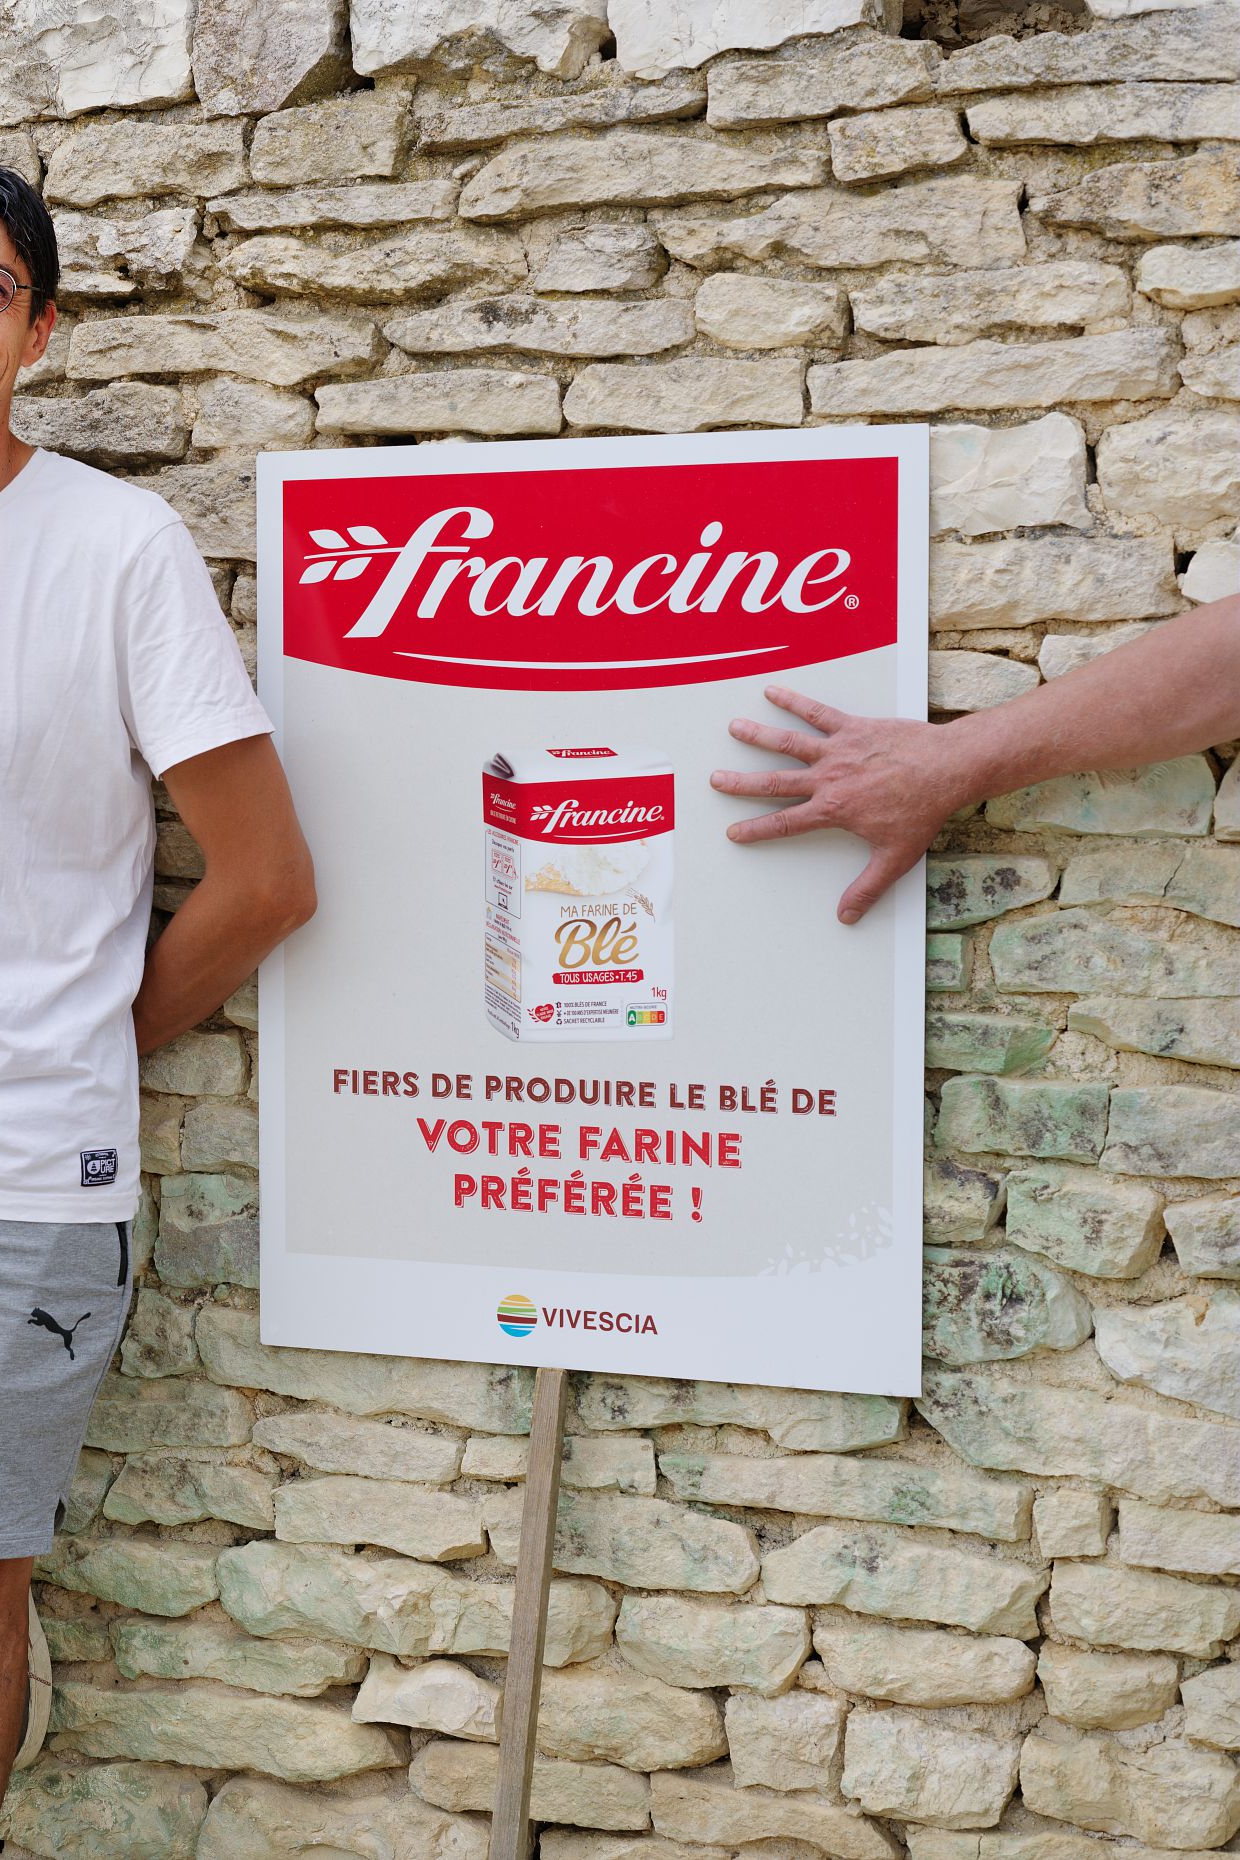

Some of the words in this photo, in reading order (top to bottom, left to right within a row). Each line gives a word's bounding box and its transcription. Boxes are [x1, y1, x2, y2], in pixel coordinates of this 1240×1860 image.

[560, 905, 579, 918] MA
[581, 904, 619, 917] FARINE
[623, 903, 638, 915] DE
[555, 917, 639, 969] Blé
[560, 973, 580, 984] TOUS
[651, 986, 667, 1001] 1kg
[333, 1069, 419, 1098] FIERS
[432, 1073, 472, 1100] DE
[485, 1075, 656, 1108] PRODUIRE
[669, 1083, 706, 1110] LE
[719, 1079, 778, 1113] BLÉ
[792, 1088, 836, 1116] DE
[416, 1117, 561, 1159] VOTRE
[579, 1125, 742, 1168] FARINE
[454, 1166, 673, 1221] PRÉFÉRÉE
[542, 1306, 658, 1335] VIVESCIA
